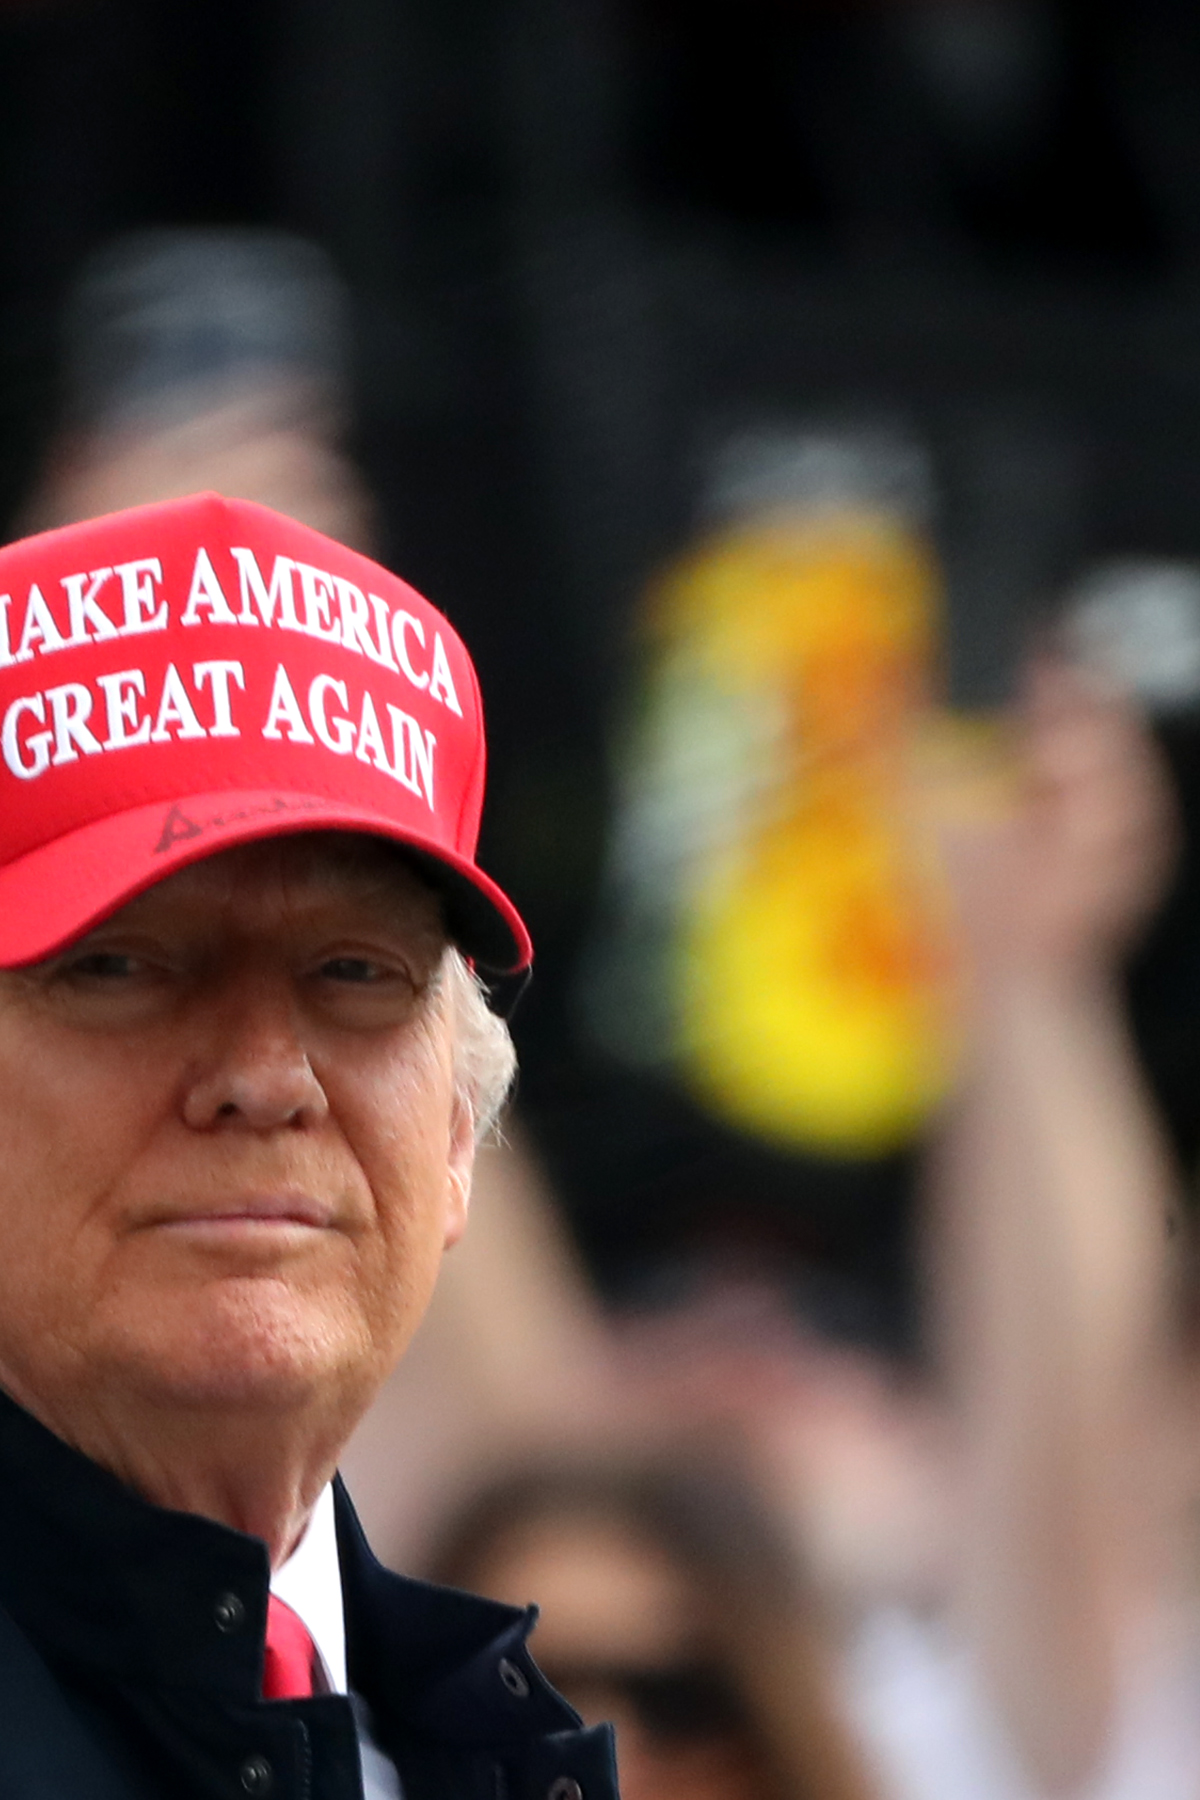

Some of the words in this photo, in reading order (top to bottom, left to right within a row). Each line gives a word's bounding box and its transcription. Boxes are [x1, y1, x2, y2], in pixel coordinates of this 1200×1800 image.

[182, 547, 462, 718] AMERICA
[1, 660, 245, 780] GREAT
[263, 664, 437, 812] AGAIN
